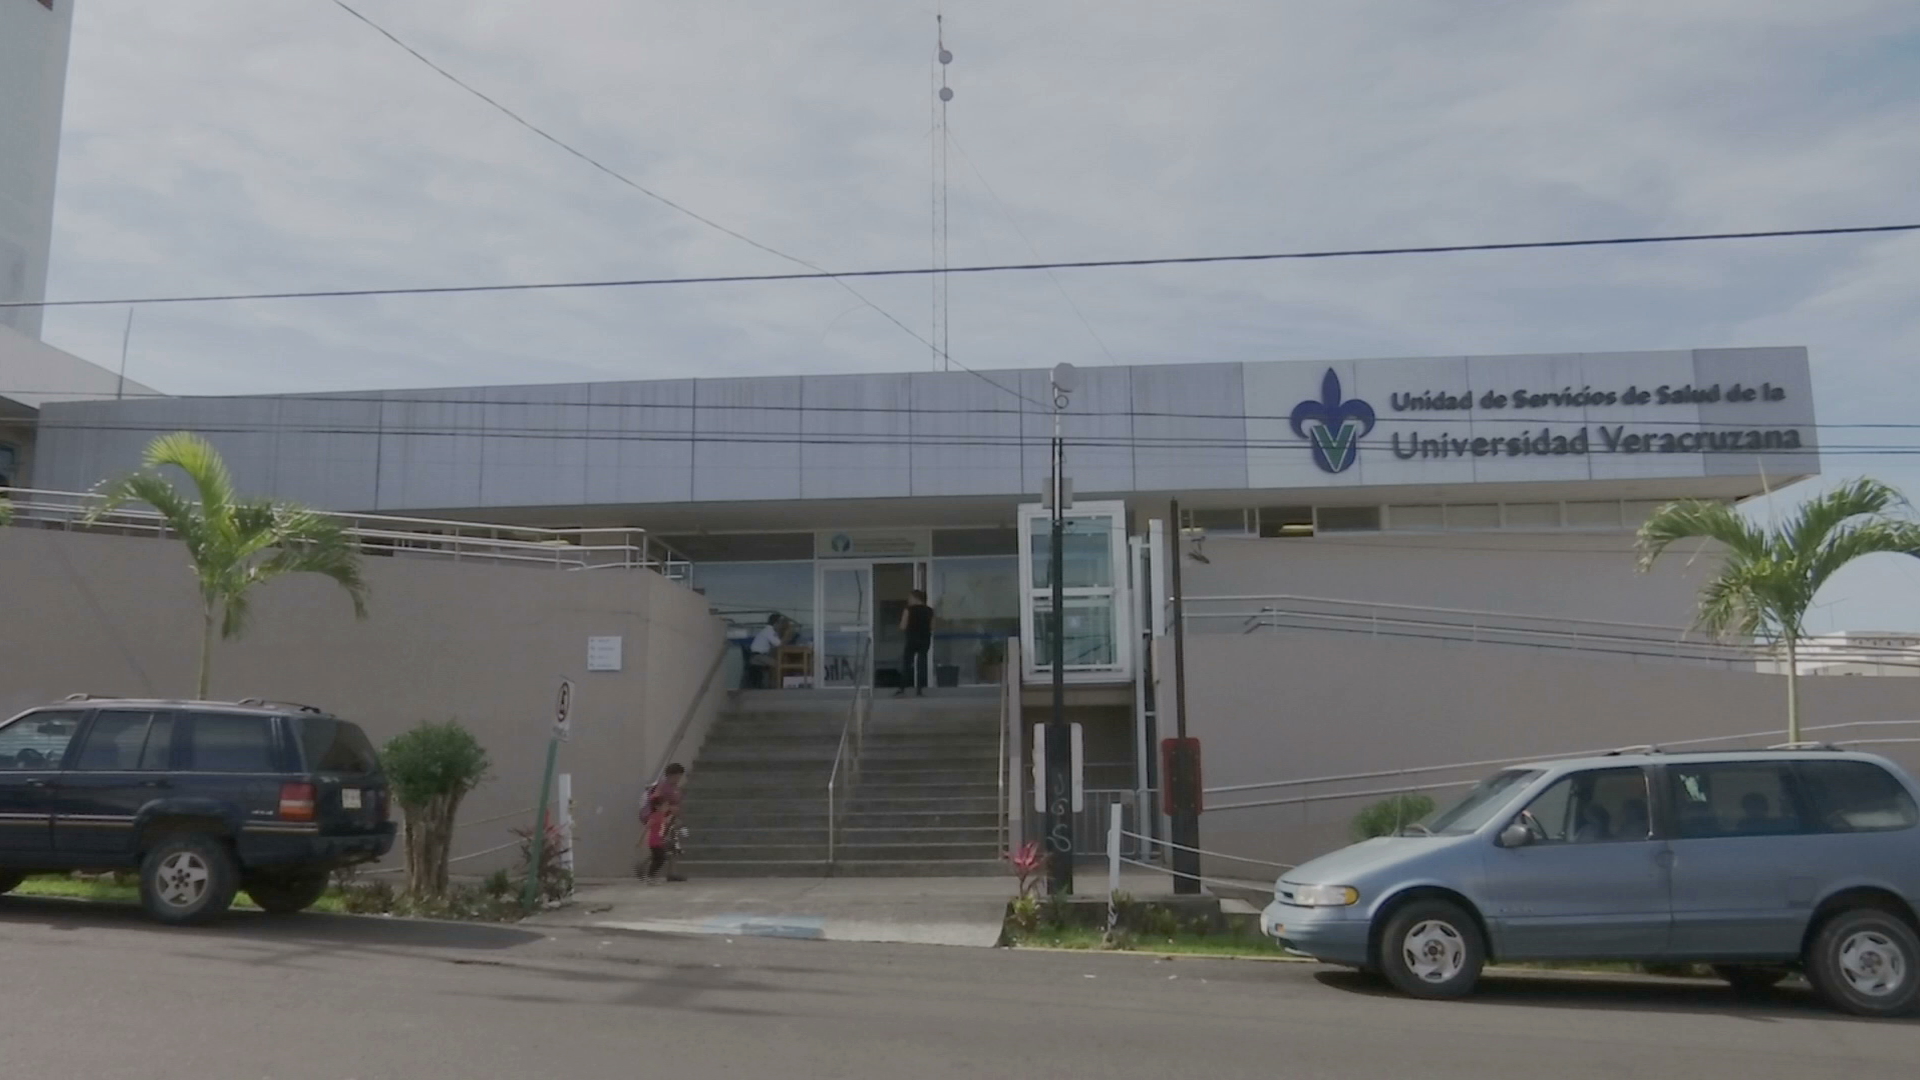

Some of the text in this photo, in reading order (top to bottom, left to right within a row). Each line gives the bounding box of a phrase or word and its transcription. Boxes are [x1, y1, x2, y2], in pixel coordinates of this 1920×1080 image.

[1390, 381, 1786, 412] Unidad de Servicios de Salud de la
[1391, 425, 1802, 460] Universidad Veracruzana
